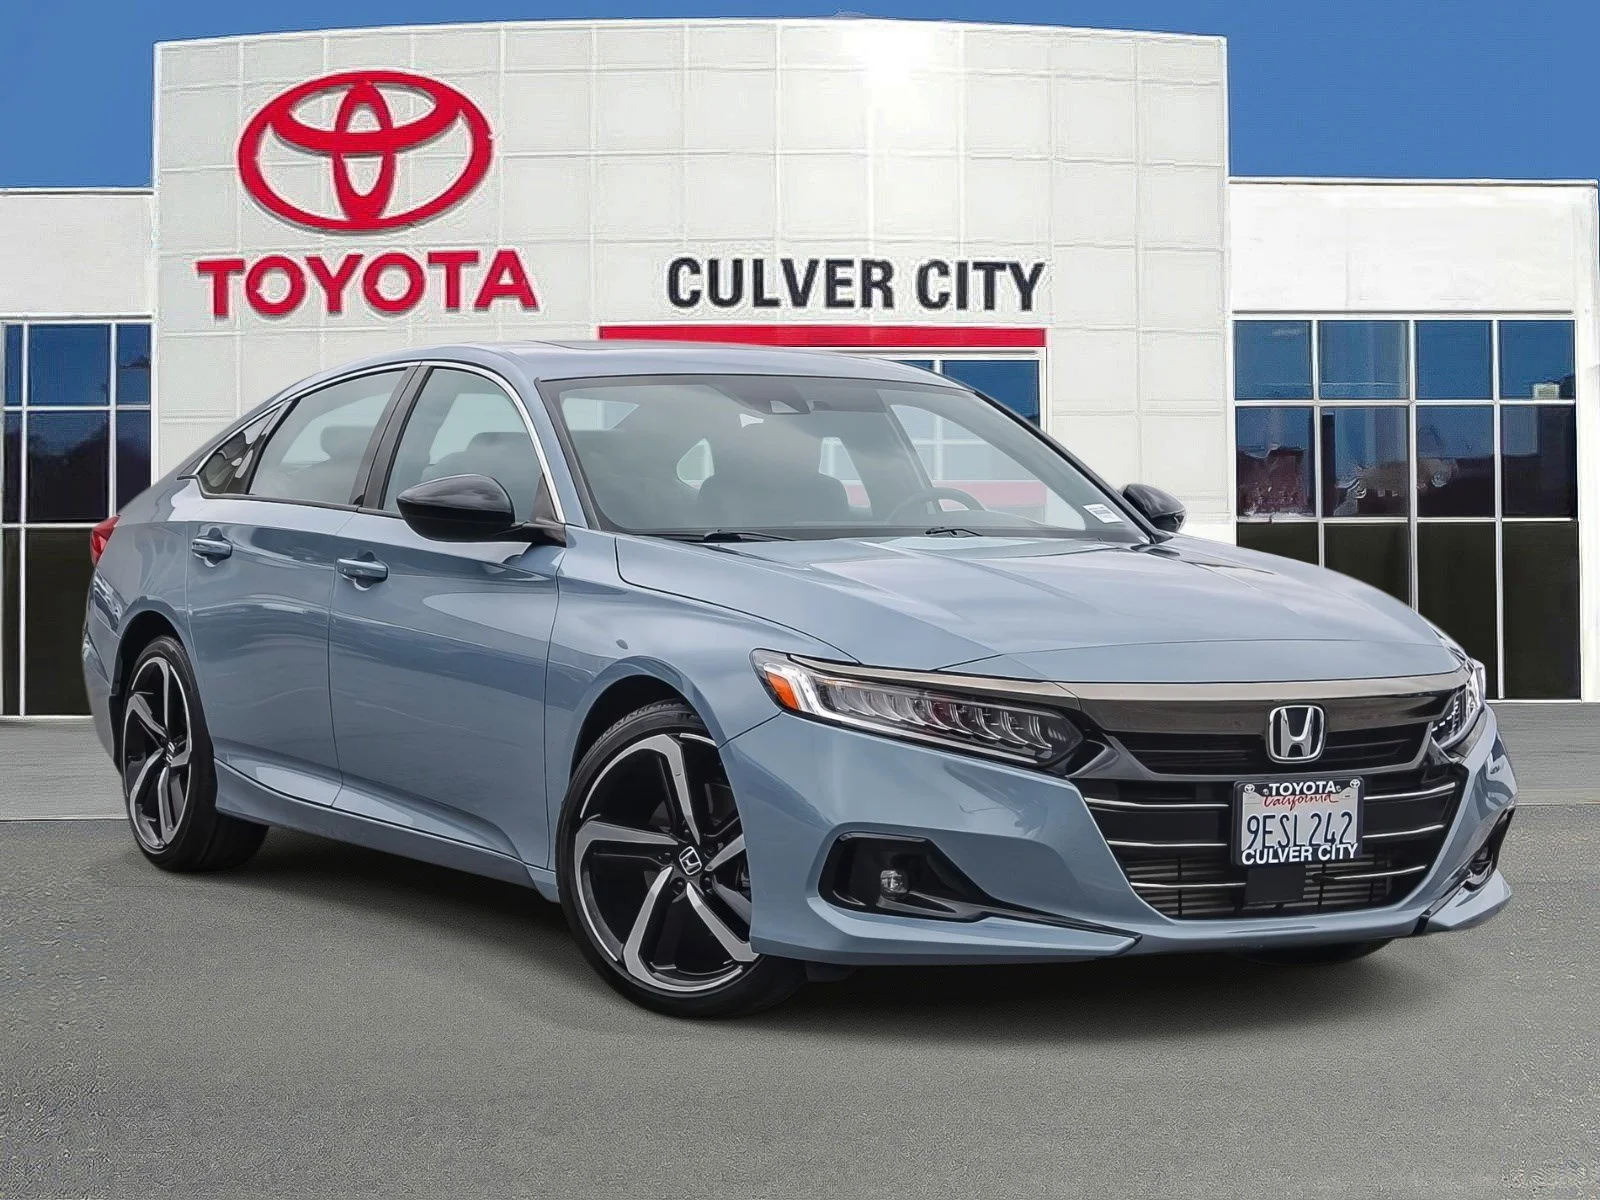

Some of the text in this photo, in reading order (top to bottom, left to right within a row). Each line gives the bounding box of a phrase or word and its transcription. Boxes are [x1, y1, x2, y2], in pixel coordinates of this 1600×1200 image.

[195, 249, 538, 318] TOYOTA
[667, 256, 1046, 312] CULVER CITY
[1263, 793, 1339, 811] California
[1268, 780, 1337, 796] TOYOTA
[1246, 811, 1353, 851] 9ESL242
[1241, 842, 1359, 865] CULVER CITY
